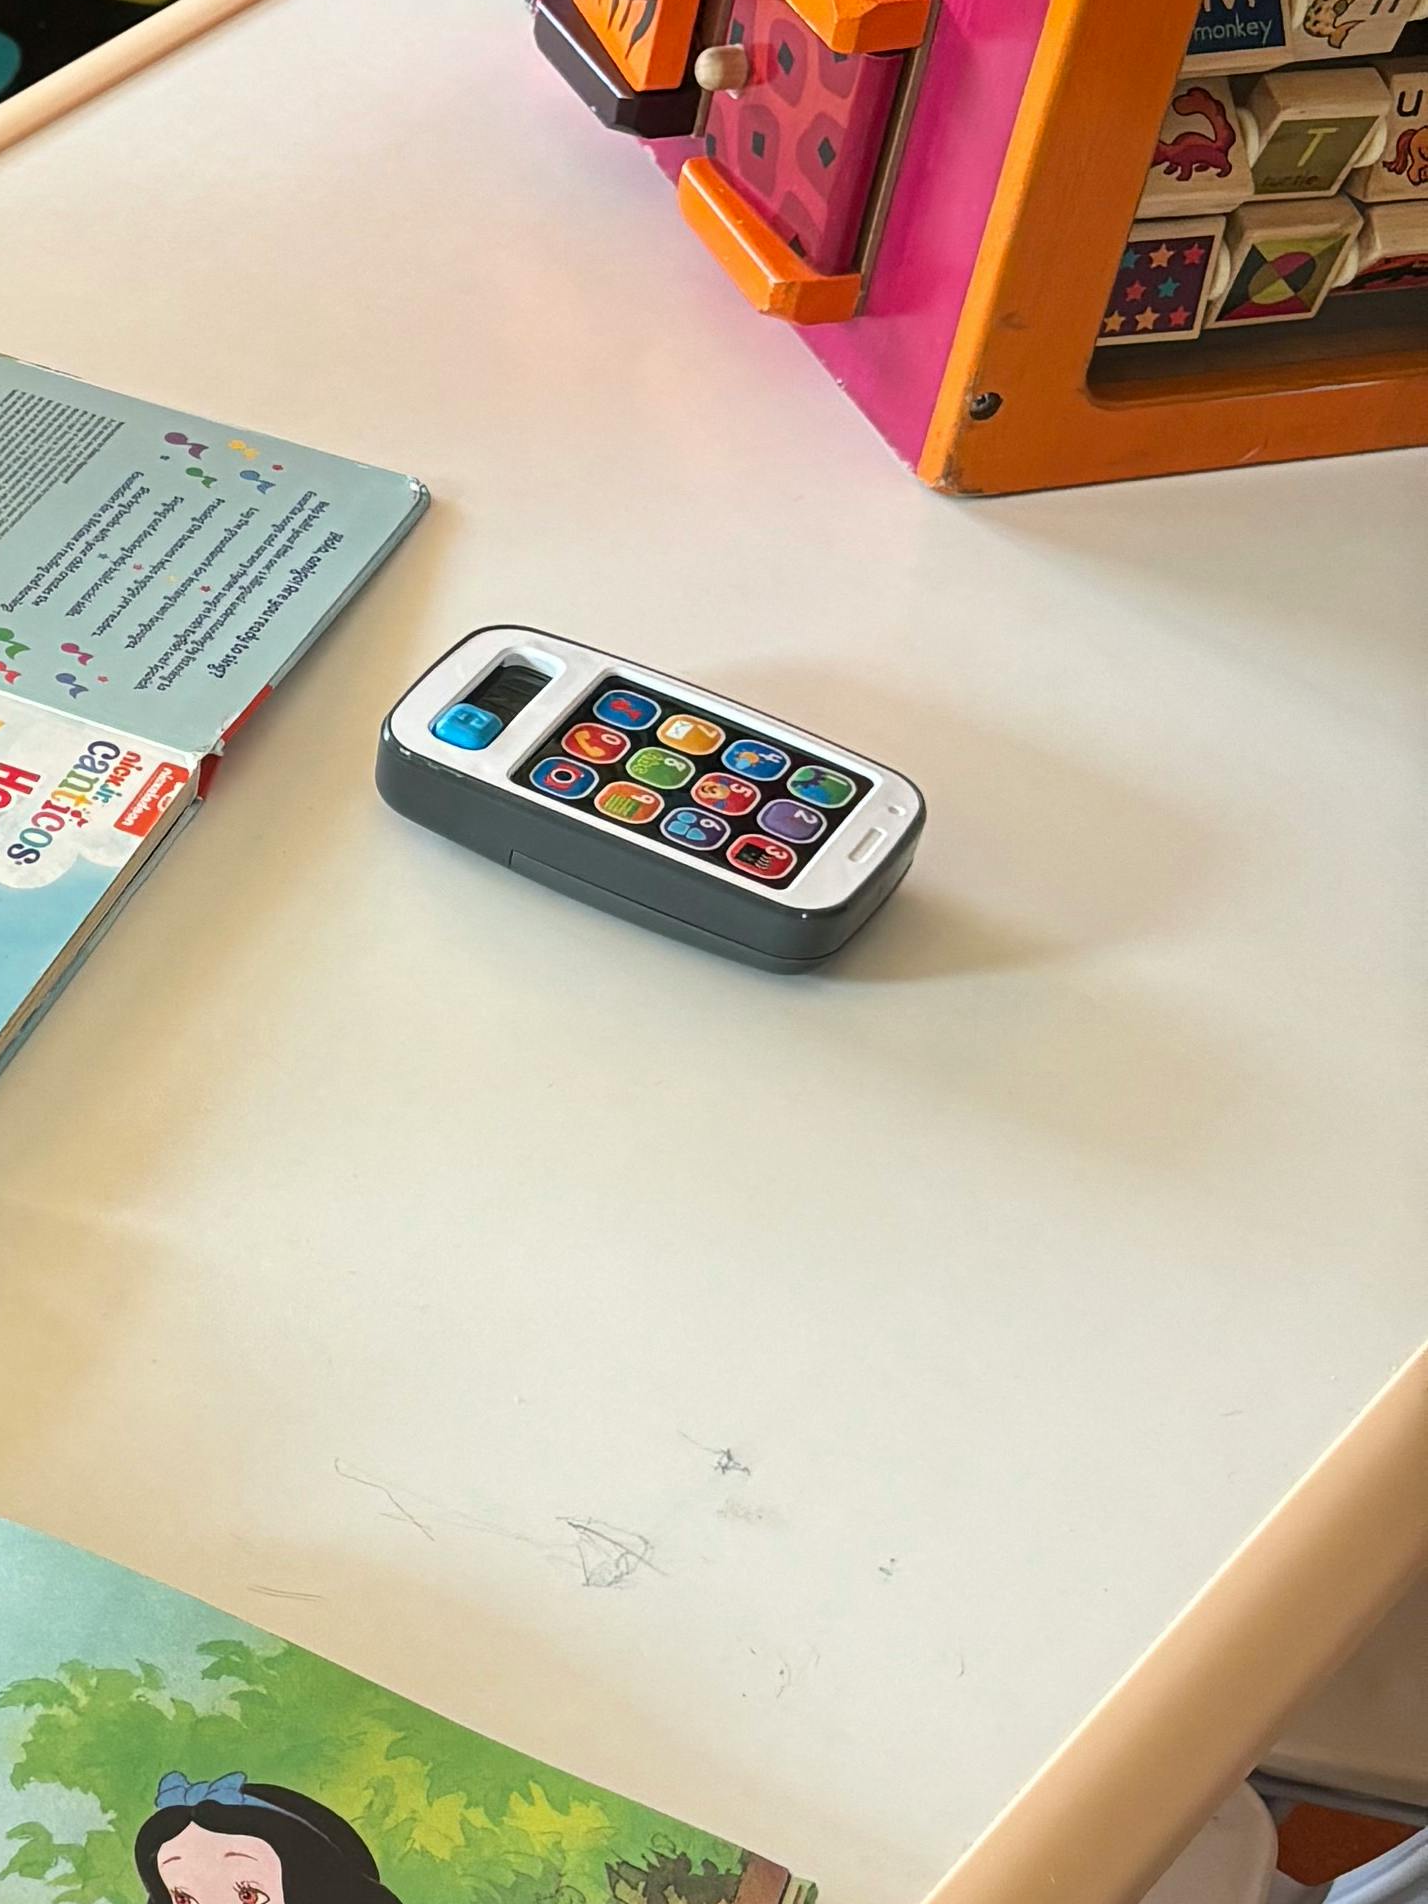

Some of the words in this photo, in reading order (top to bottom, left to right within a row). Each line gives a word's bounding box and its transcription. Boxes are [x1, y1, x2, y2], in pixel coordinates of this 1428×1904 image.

[1193, 10, 1273, 45] monkey
[1396, 88, 1424, 118] u
[1296, 127, 1340, 168] T
[275, 583, 300, 601] Are
[261, 597, 284, 618] you
[234, 615, 270, 644] ready
[229, 642, 250, 655] to
[206, 652, 238, 679] sing?
[112, 751, 143, 787] nick
[662, 756, 688, 773] 8
[730, 782, 753, 798] 5
[7, 740, 121, 865] canticos
[793, 809, 818, 825] 2
[768, 845, 788, 861] 3
